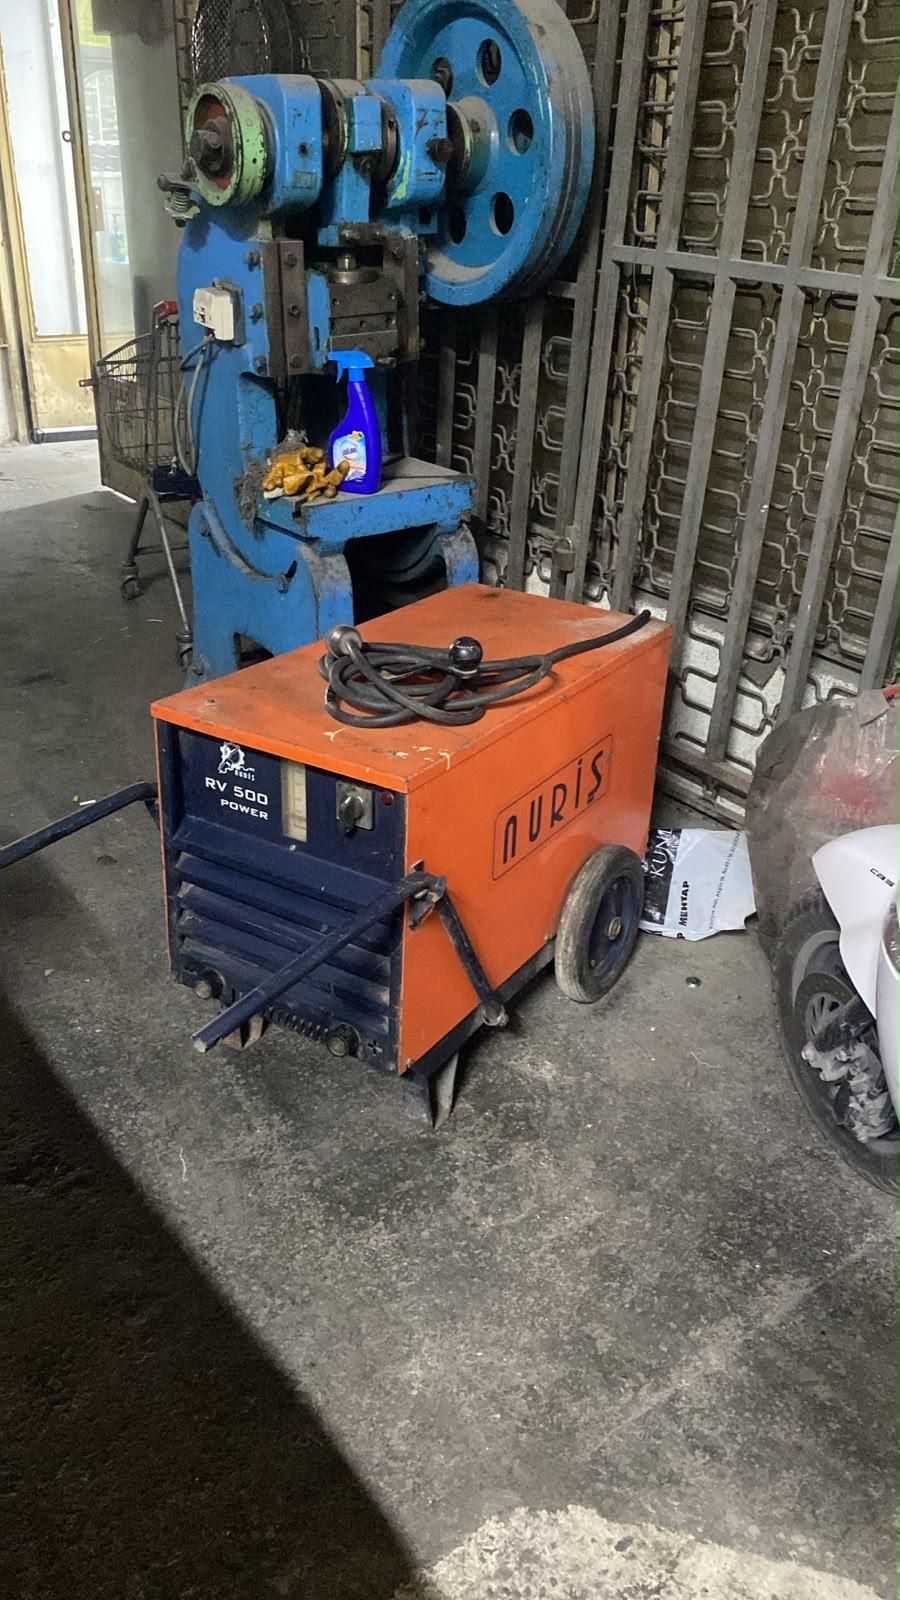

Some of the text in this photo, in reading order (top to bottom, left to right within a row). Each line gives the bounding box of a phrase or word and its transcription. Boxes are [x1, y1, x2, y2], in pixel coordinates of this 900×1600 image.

[205, 777, 269, 806] RV 500
[220, 798, 268, 820] POWER
[678, 880, 690, 927] MEHTAP
